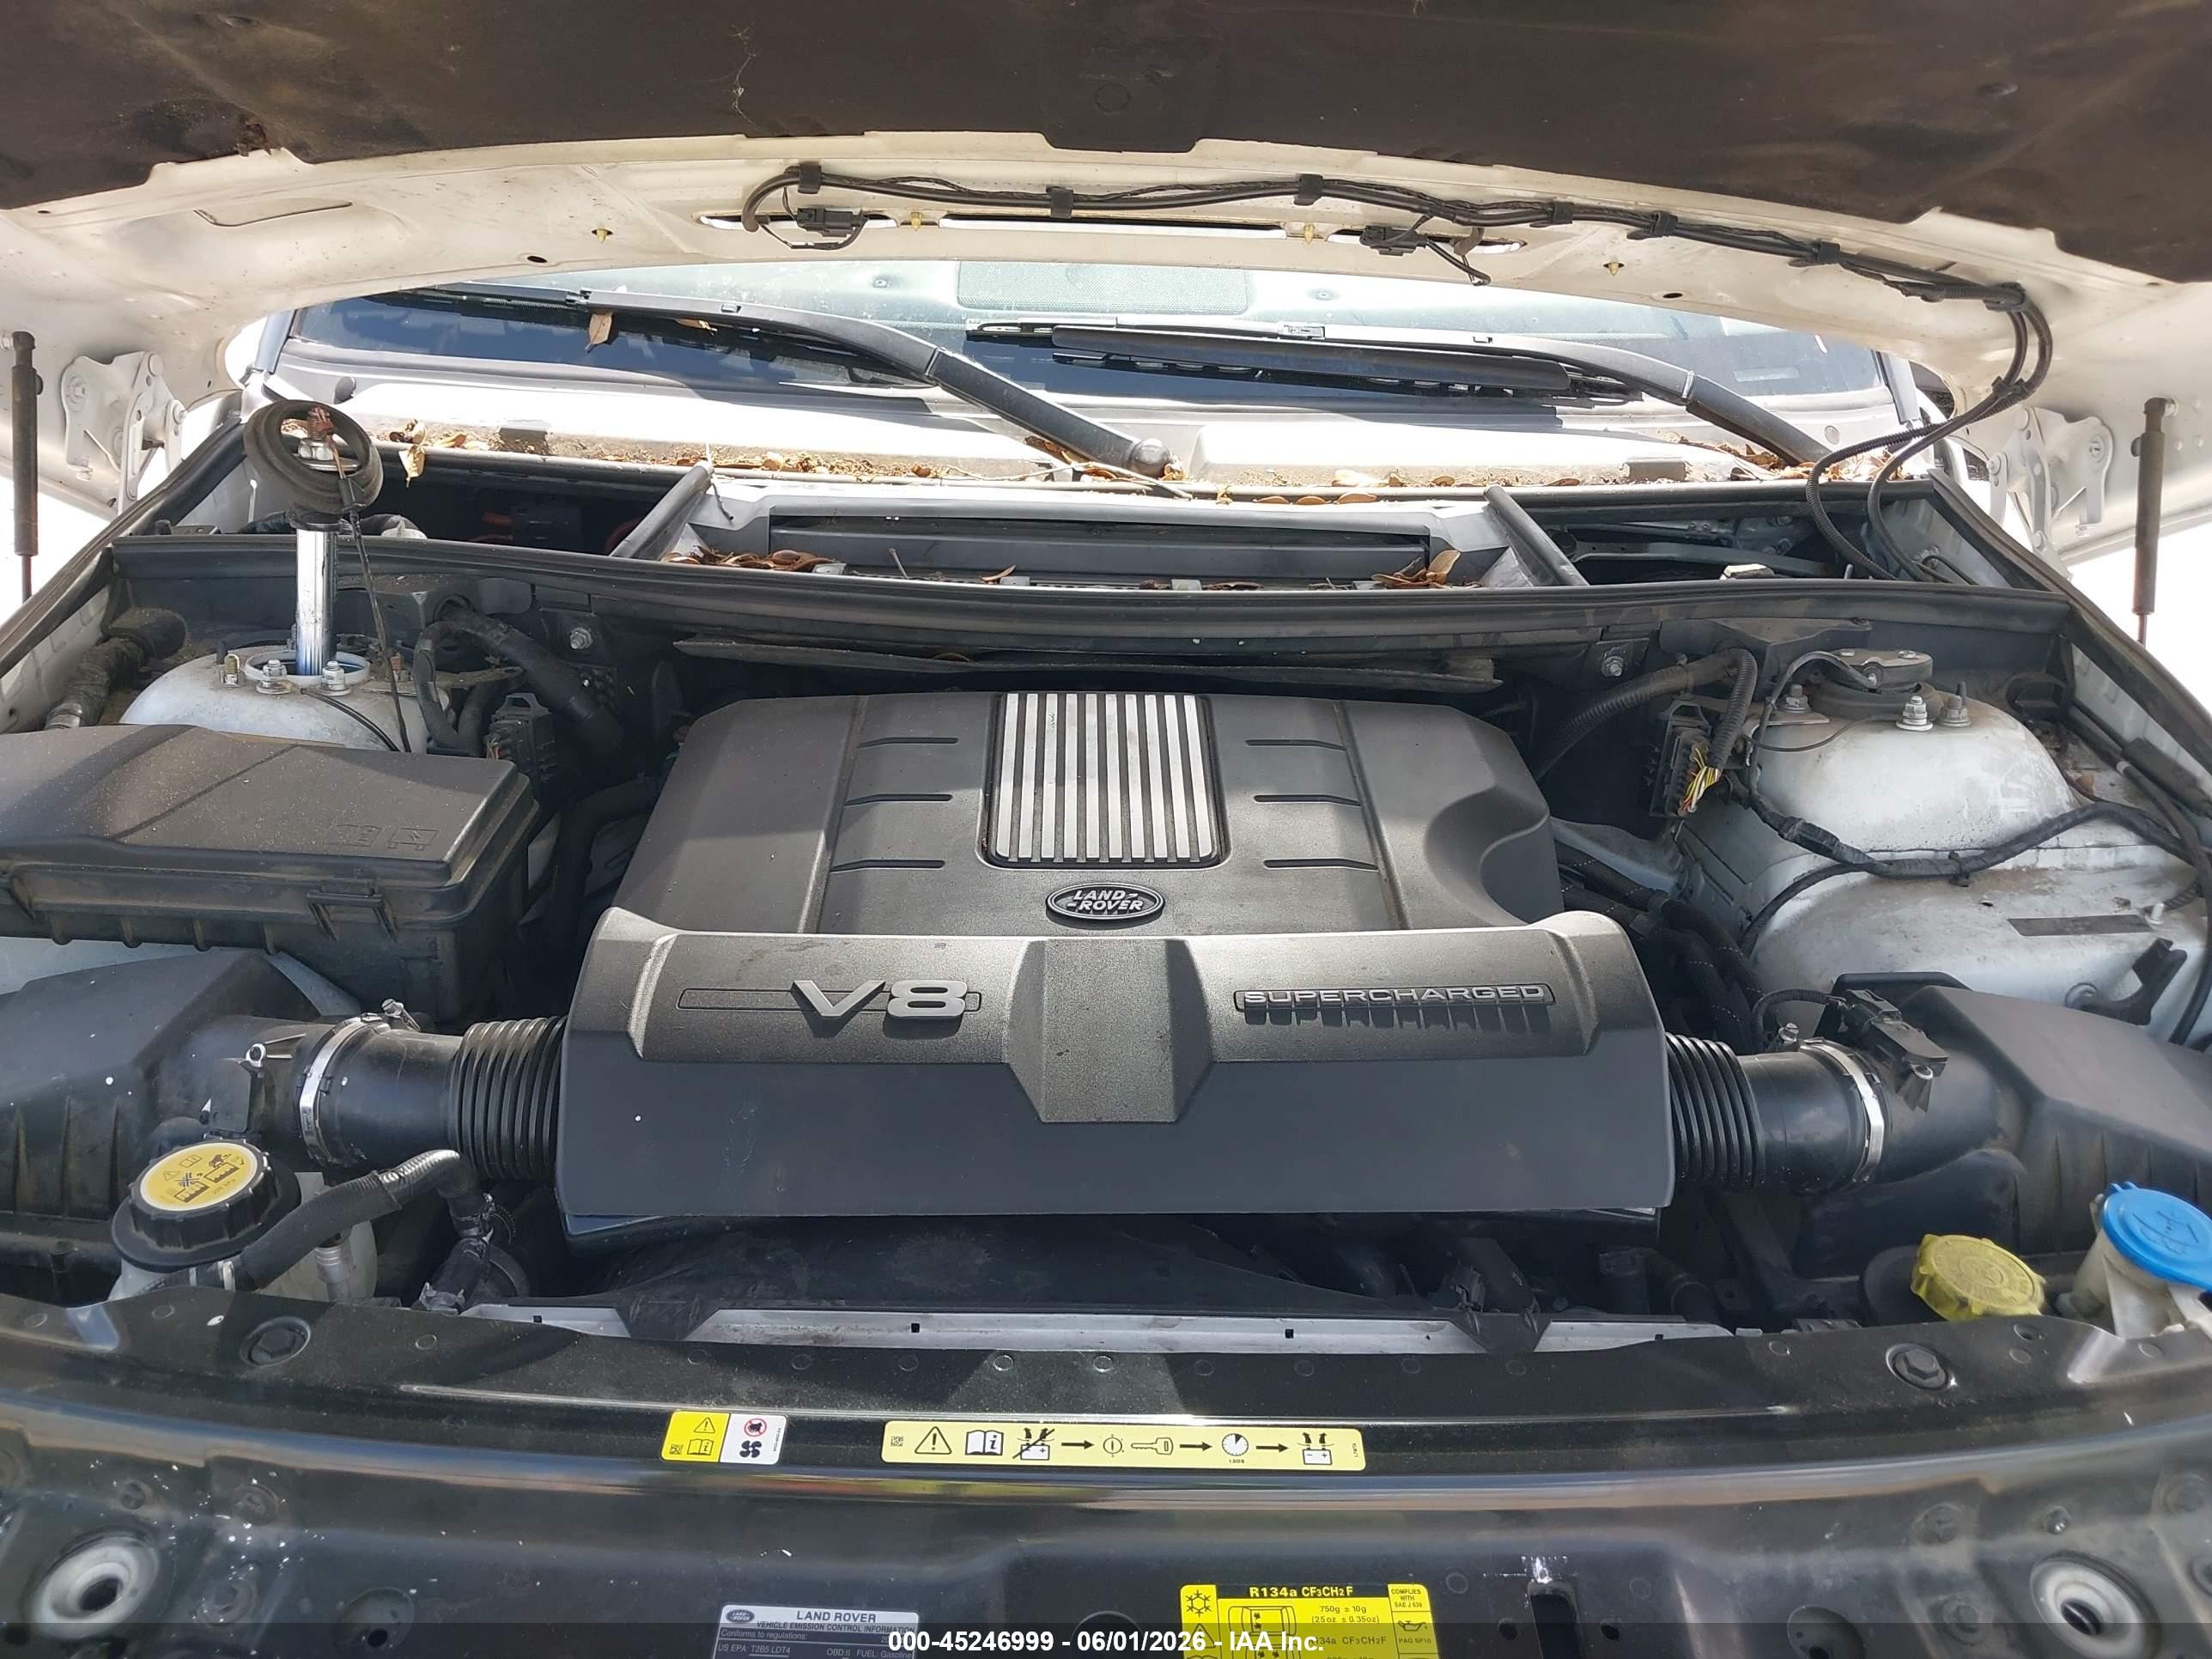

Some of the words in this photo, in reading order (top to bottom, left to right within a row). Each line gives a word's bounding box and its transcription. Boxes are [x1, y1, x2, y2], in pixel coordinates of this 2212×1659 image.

[1079, 900, 1144, 911] ROVER
[790, 980, 968, 1018] V8
[1244, 986, 1546, 1004] SUPERCHARGED
[1249, 1587, 1297, 1597] R134a
[797, 1611, 830, 1621] LAND
[835, 1613, 876, 1623] ROVER
[864, 1625, 915, 1633] INFORMATION
[718, 1644, 729, 1652] US
